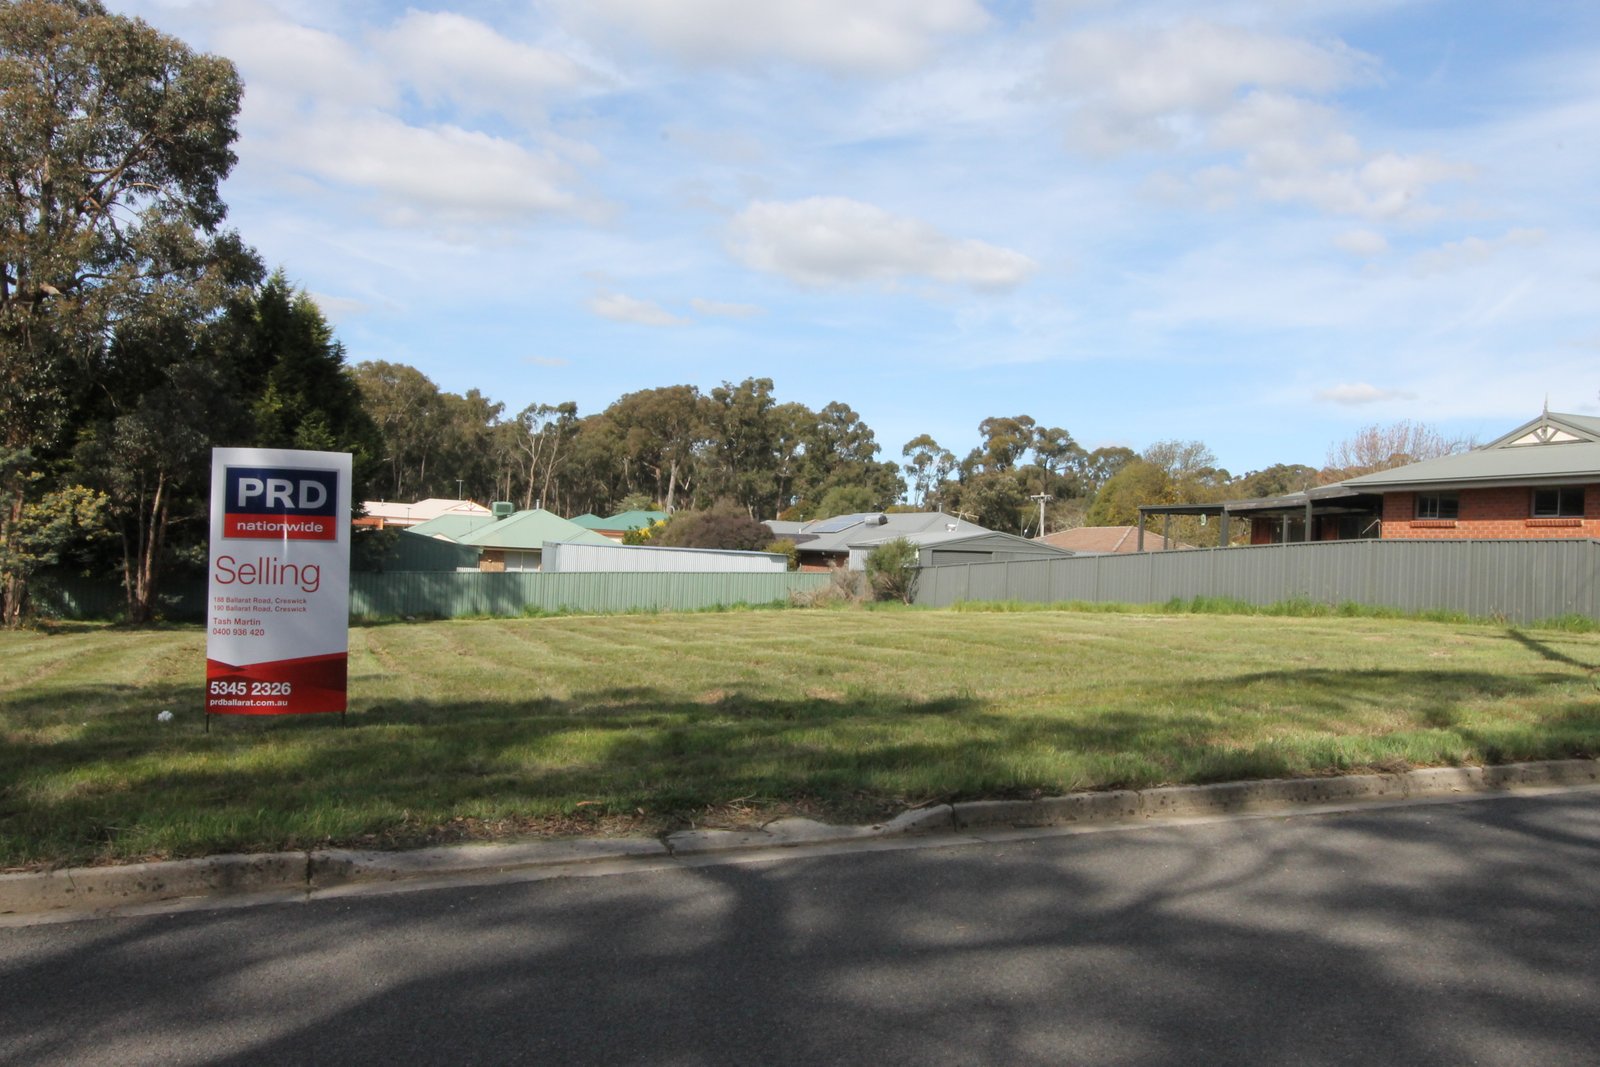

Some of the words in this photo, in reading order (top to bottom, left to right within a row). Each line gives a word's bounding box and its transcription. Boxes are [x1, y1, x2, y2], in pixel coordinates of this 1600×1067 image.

[237, 477, 328, 509] PRD
[236, 520, 324, 533] nationwide
[215, 555, 320, 593] Selling
[253, 605, 273, 613] Road,
[234, 618, 261, 626] Martin
[233, 628, 247, 636] 936
[250, 628, 265, 636] 420
[210, 681, 247, 695] 5345
[251, 682, 292, 696] 2326
[209, 699, 288, 707] prdballarat.com.au
